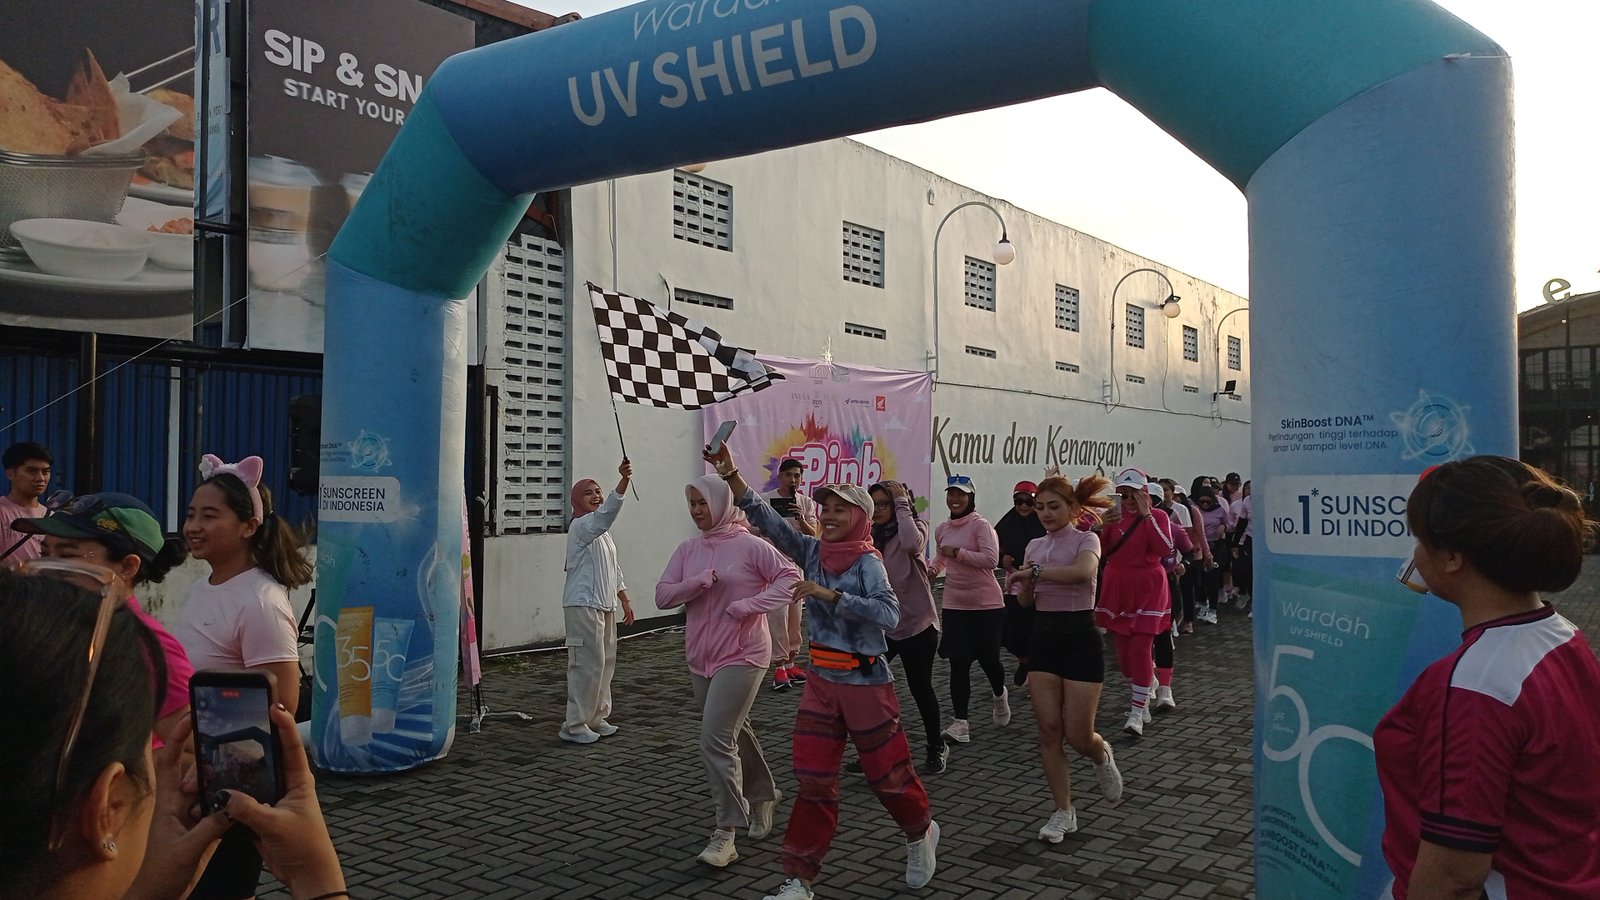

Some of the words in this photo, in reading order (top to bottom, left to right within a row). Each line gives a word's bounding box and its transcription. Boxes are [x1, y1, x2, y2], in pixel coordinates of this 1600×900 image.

[632, 0, 779, 40] Ward
[264, 29, 325, 74] SIP
[336, 52, 364, 88] &
[567, 61, 640, 127] UV
[652, 5, 878, 109] SHIELD
[283, 78, 349, 111] START
[355, 97, 405, 126] YOUR
[1281, 417, 1332, 430] SkinBoost
[1268, 431, 1315, 442] Perlindungan
[1319, 430, 1347, 441] tinggi
[1349, 428, 1398, 439] terhadap
[931, 416, 996, 477] Kamu
[1003, 421, 1038, 465] dan
[1273, 444, 1289, 452] sinar
[1290, 443, 1301, 451] UV
[1302, 441, 1337, 453] sampai
[1339, 441, 1362, 450] level
[323, 487, 385, 500] SUNSCREEN
[330, 500, 385, 512] INDONESIA
[1321, 519, 1340, 536] DI
[1290, 626, 1303, 635] UV
[1304, 628, 1344, 647] SHIELD
[337, 636, 372, 682] 35
